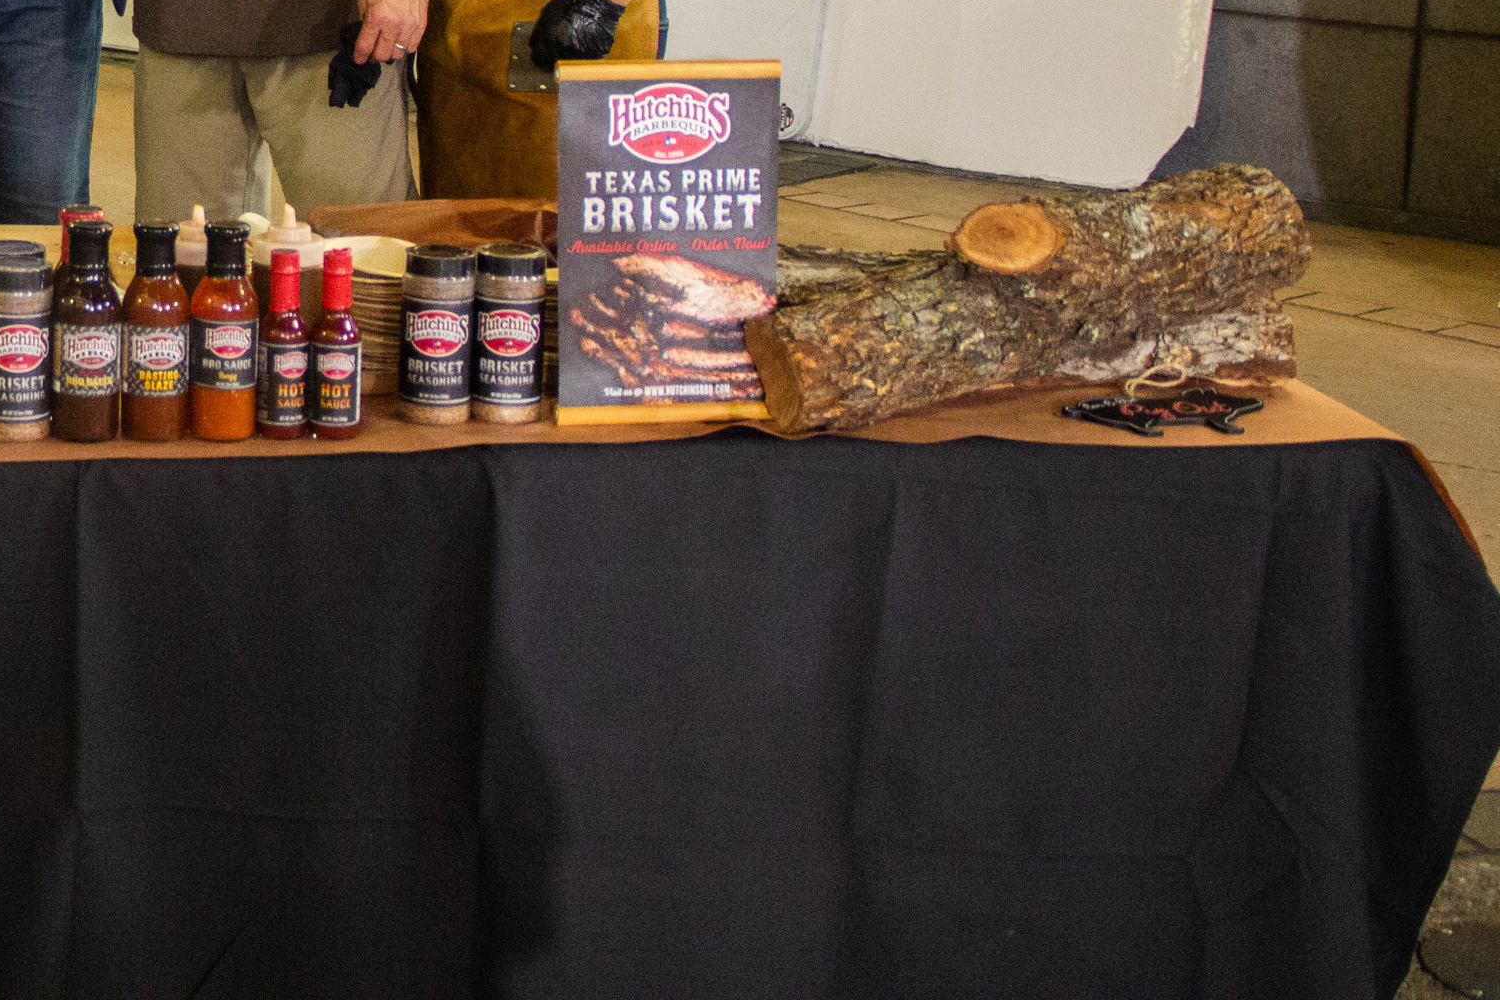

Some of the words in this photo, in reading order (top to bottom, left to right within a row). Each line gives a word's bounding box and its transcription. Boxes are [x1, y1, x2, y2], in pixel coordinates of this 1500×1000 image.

[632, 119, 708, 137] BARBEQUE
[586, 170, 672, 194] TEXAS
[681, 168, 761, 193] PRIME
[583, 194, 762, 233] BRISKET
[567, 239, 633, 253] Available
[636, 238, 678, 253] Online
[691, 237, 730, 251] Order
[733, 236, 771, 250] Now!
[408, 357, 464, 374] BRISKET
[479, 357, 535, 374] BRISKET
[407, 373, 463, 386] SEASONING
[479, 373, 535, 386] SEASONING
[278, 382, 306, 397] HOT
[321, 383, 352, 398] HOT
[321, 398, 352, 410] SAUCE
